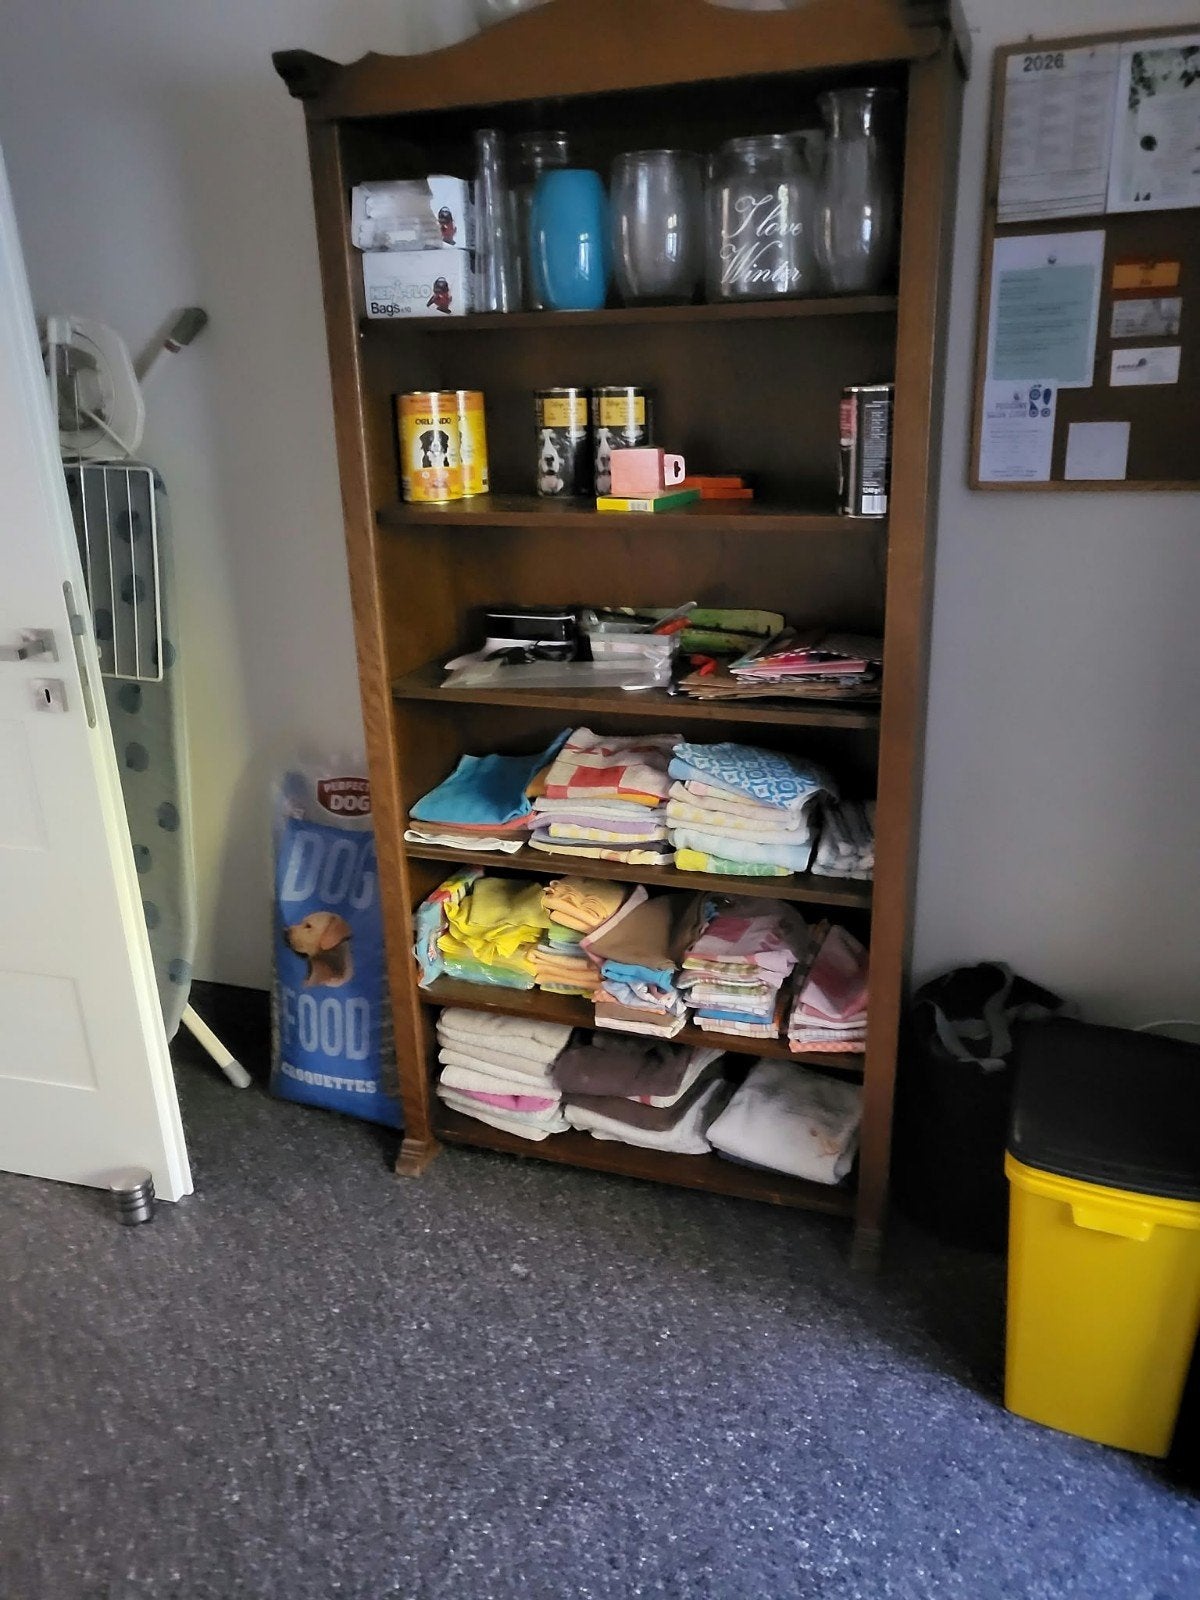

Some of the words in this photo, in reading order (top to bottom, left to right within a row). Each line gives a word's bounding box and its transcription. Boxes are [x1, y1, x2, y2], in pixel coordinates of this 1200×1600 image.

[370, 302, 400, 317] Bags
[330, 794, 370, 811] DOG
[281, 830, 376, 910] DOG
[283, 988, 370, 1060] FOOD
